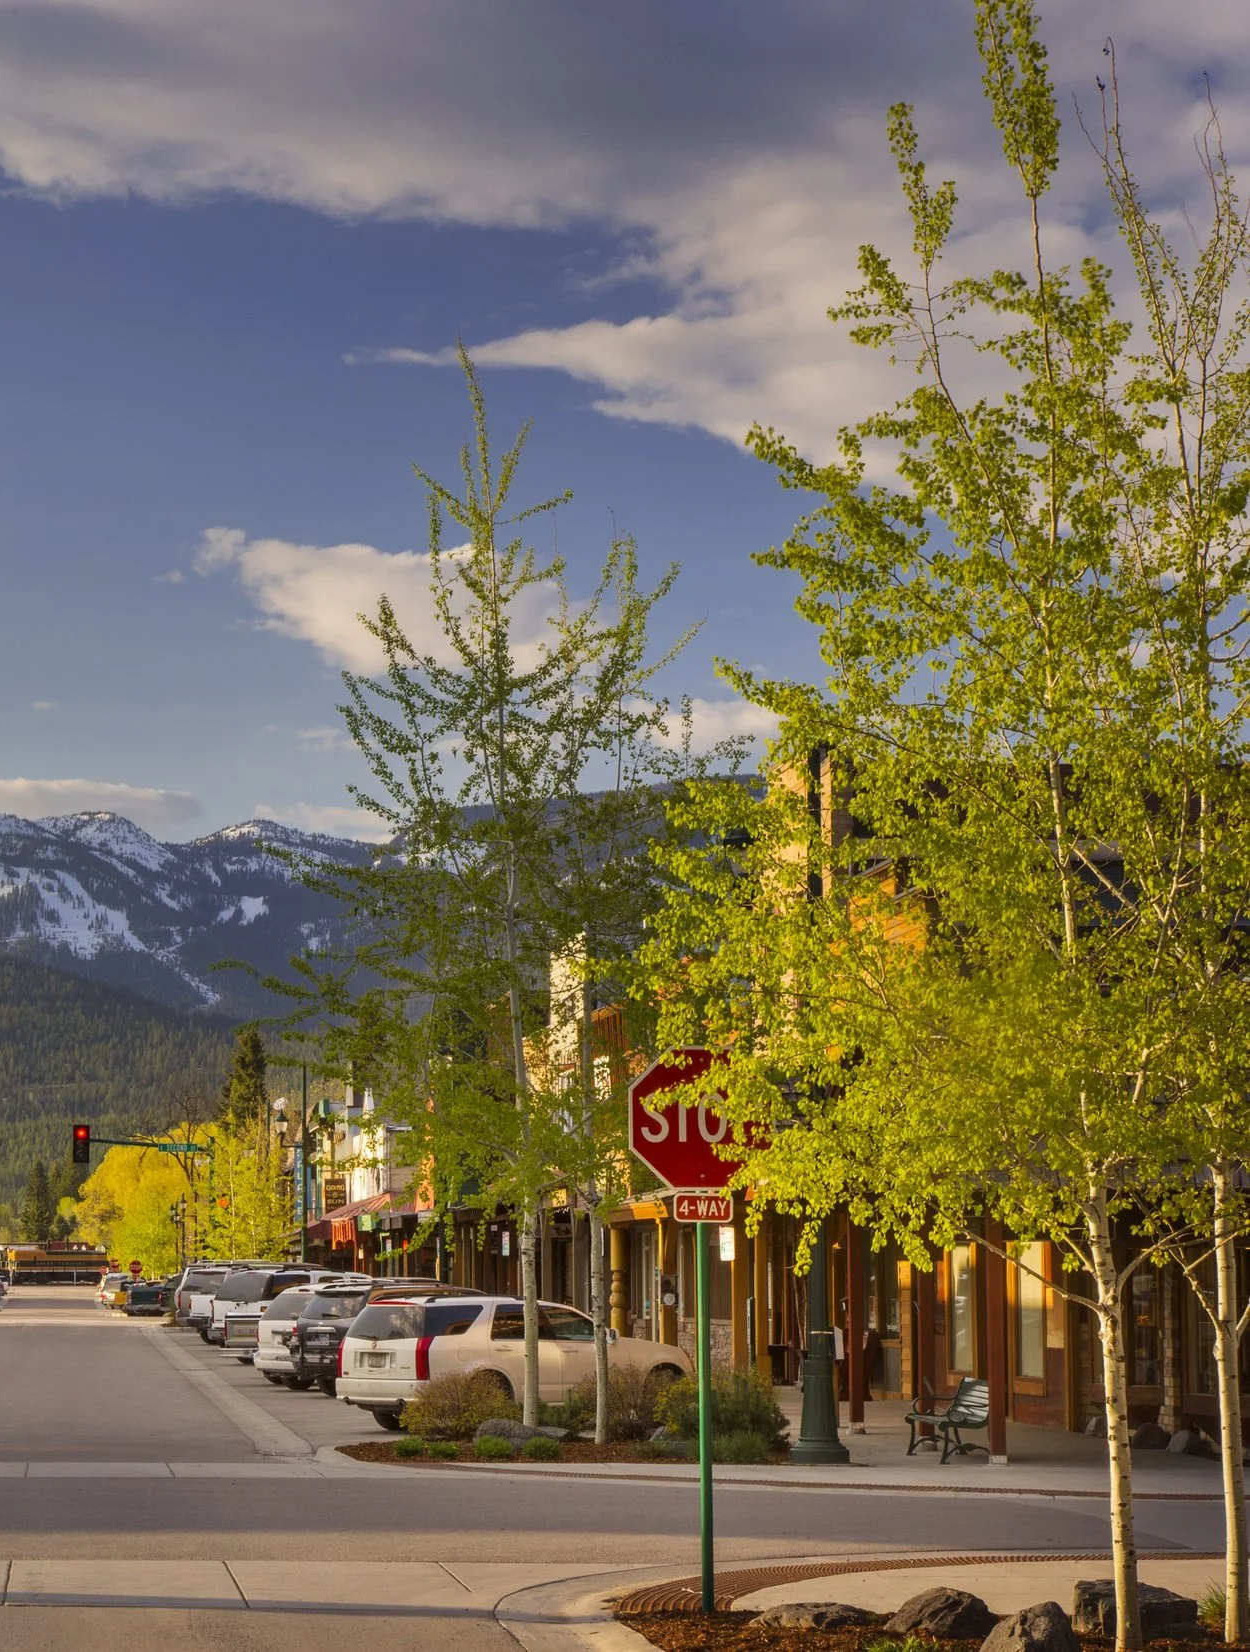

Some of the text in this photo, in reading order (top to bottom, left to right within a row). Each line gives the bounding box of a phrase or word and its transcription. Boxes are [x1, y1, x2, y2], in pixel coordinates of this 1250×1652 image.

[640, 1092, 736, 1144] STO
[326, 1184, 345, 1192] GOING
[679, 1200, 728, 1217] 4-WAY
